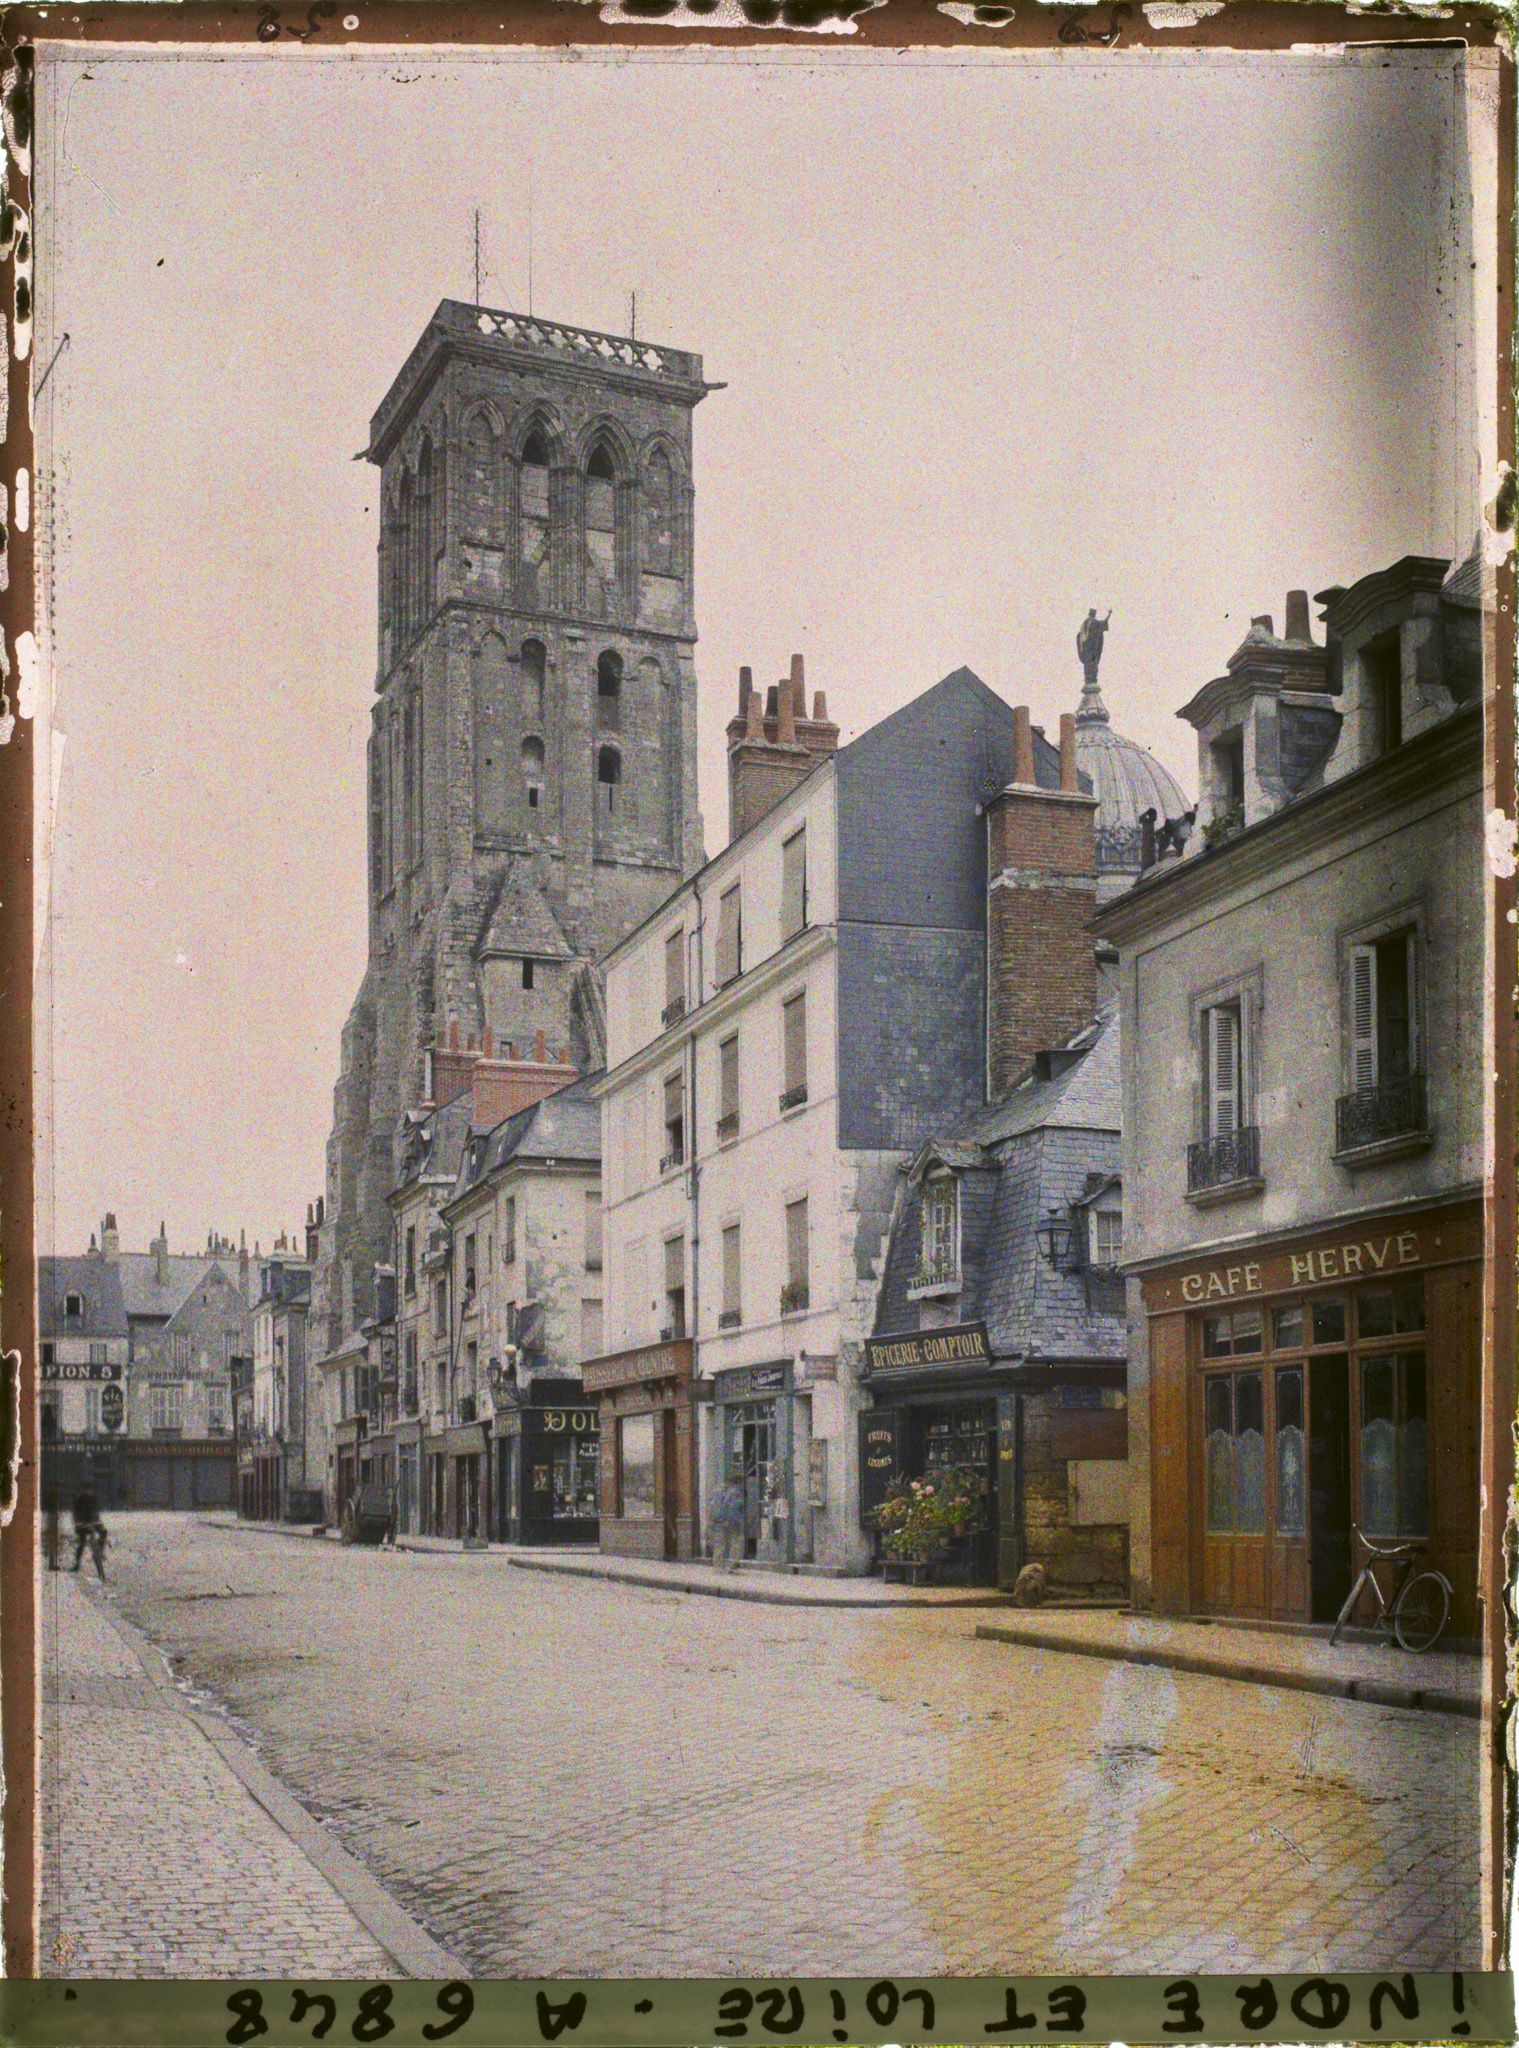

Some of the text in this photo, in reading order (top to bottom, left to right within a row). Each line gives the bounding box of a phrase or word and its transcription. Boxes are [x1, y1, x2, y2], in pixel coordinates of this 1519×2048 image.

[1180, 1231, 1420, 1302] CAFÉ HERVÉ
[536, 1990, 588, 2040] A
[985, 1985, 1087, 2033] ET
